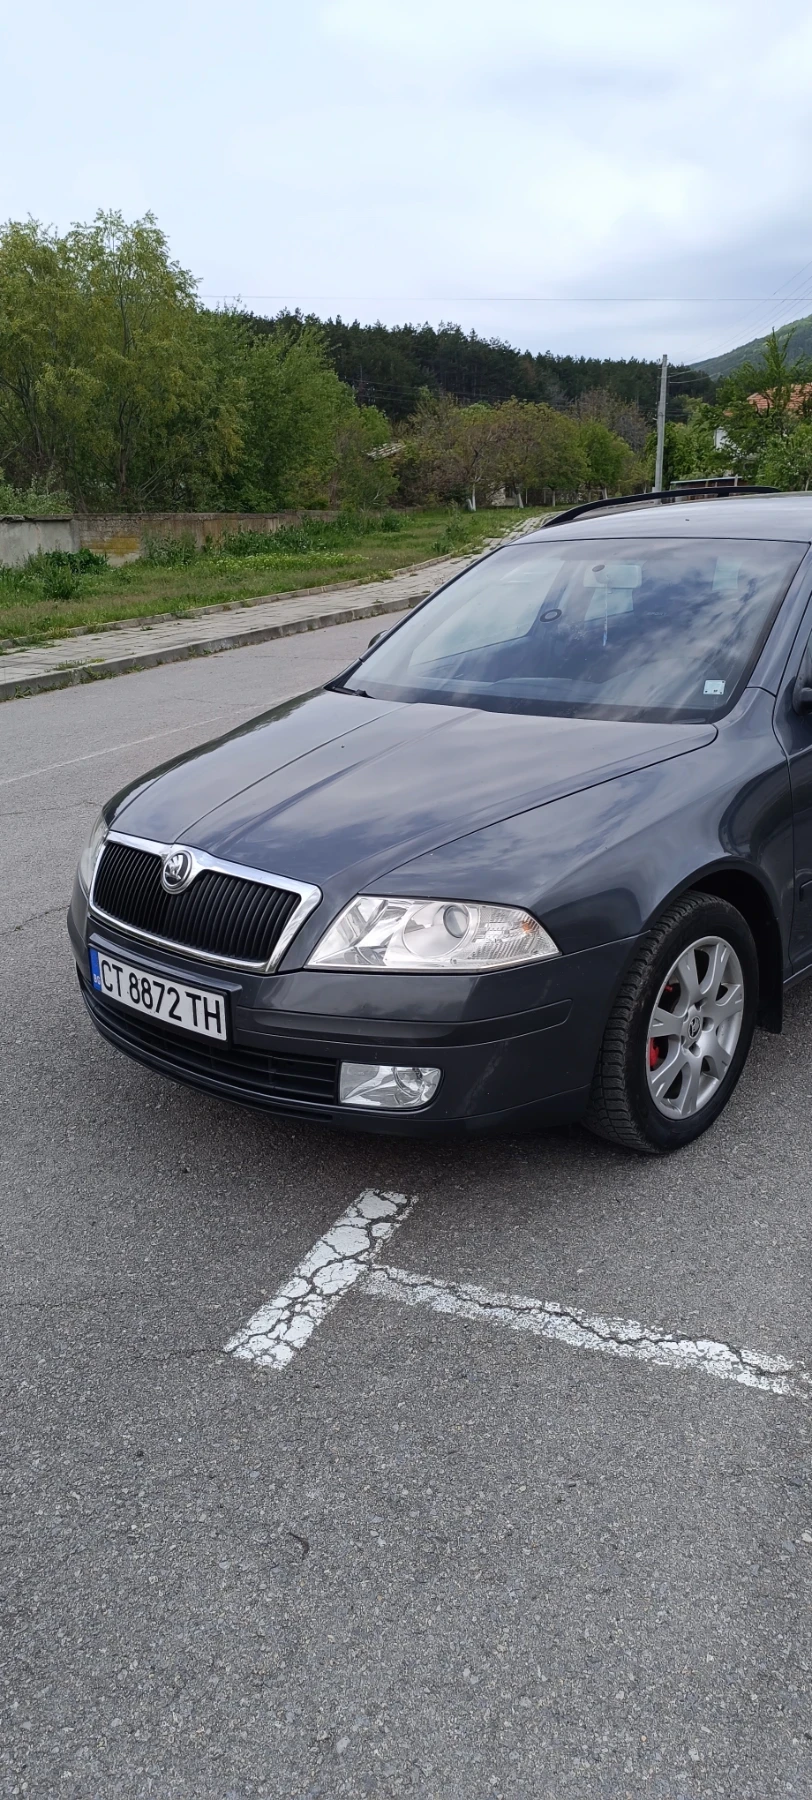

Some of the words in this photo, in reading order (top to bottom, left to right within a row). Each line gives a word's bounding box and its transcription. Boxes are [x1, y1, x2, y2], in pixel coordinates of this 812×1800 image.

[93, 974, 101, 985] BG
[101, 959, 123, 997] CT
[128, 972, 182, 1022] 8872
[185, 991, 222, 1034] TH
